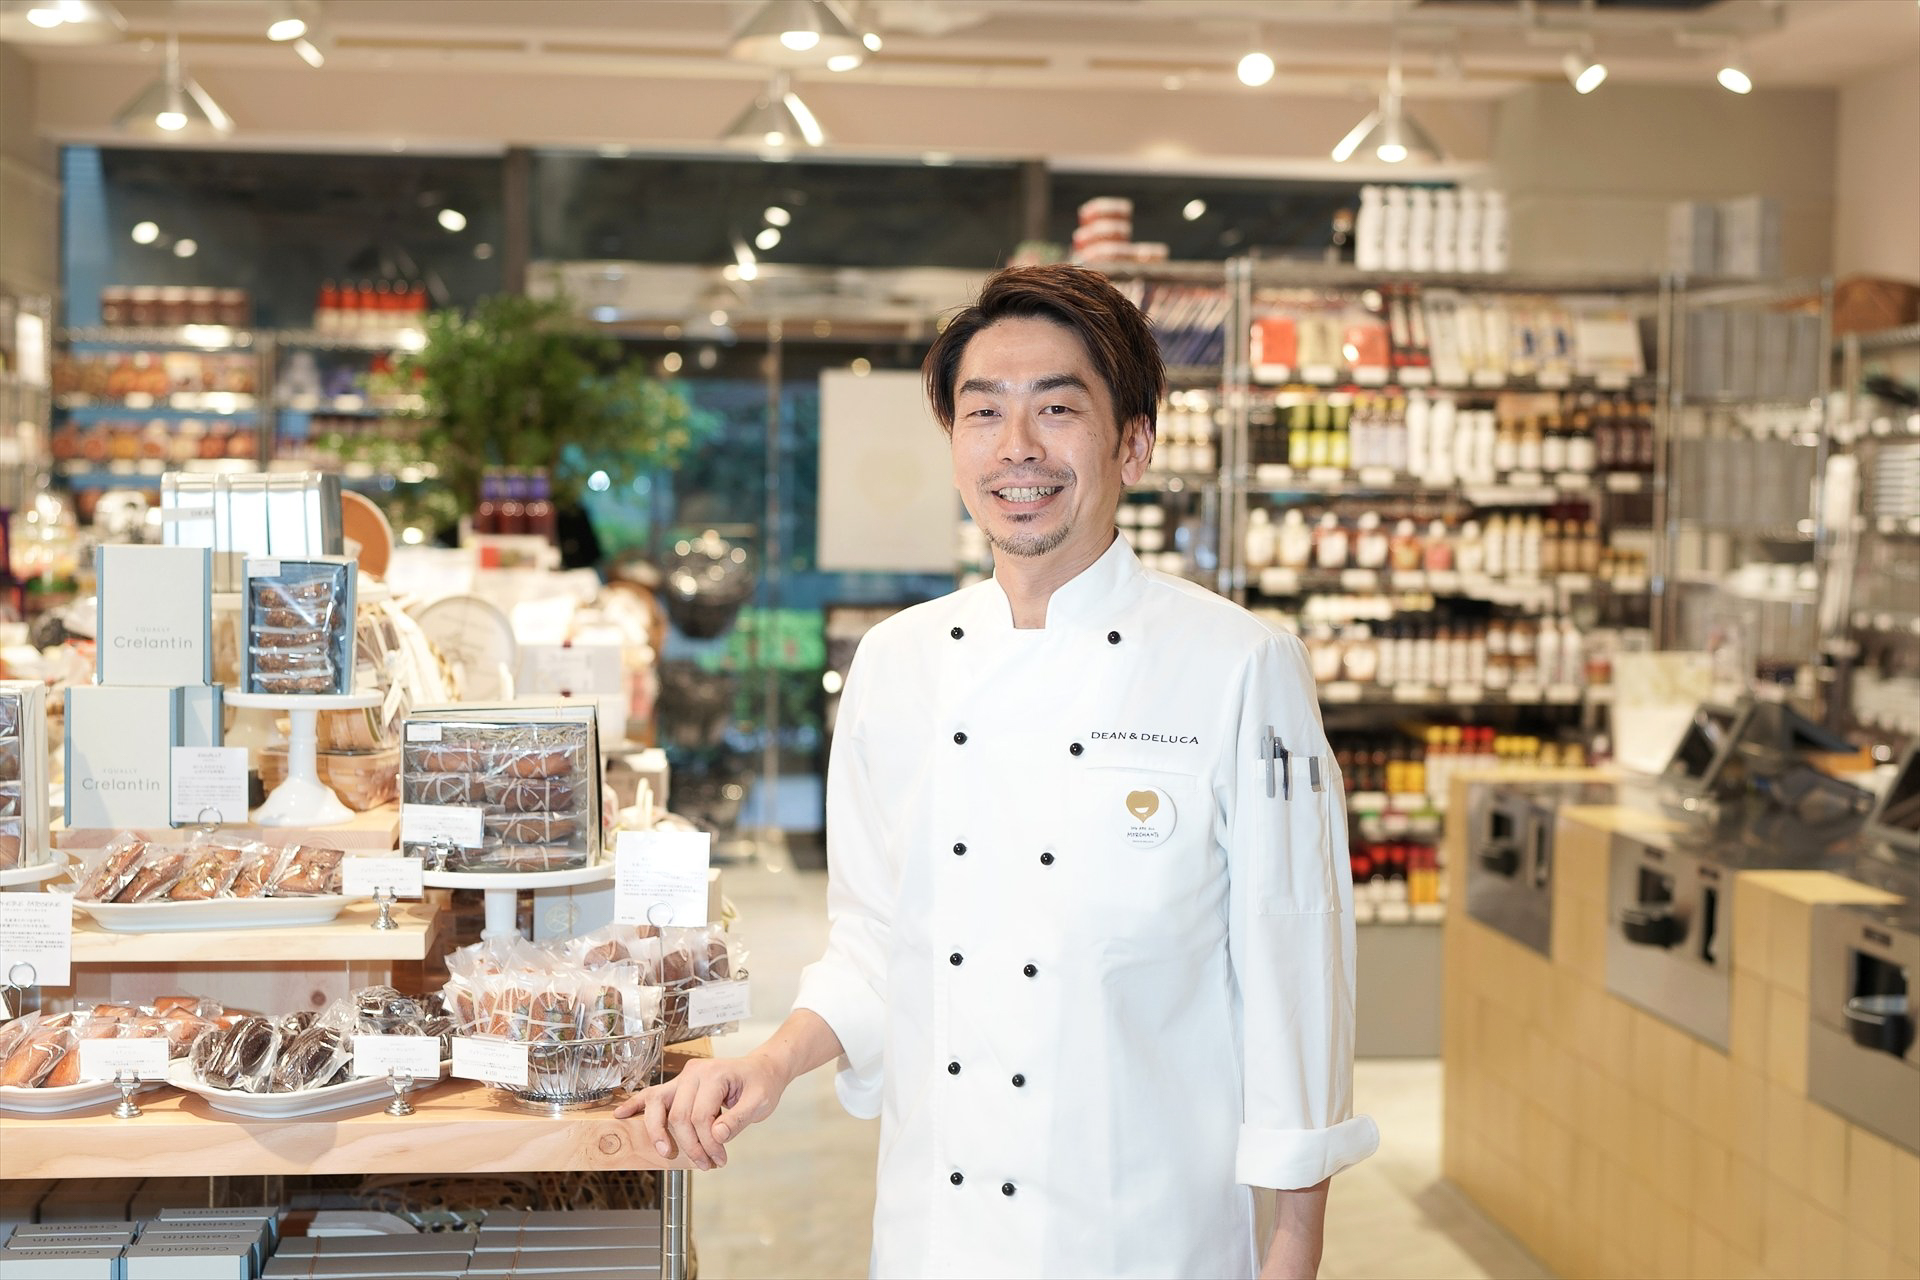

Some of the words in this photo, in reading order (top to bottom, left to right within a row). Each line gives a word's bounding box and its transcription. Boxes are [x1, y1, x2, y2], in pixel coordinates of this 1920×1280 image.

[113, 635, 193, 649] Crelantin
[1091, 731, 1127, 740] DEAN
[1129, 732, 1138, 740] &
[1141, 733, 1199, 745] DELUCA
[82, 777, 161, 791] Crelantin
